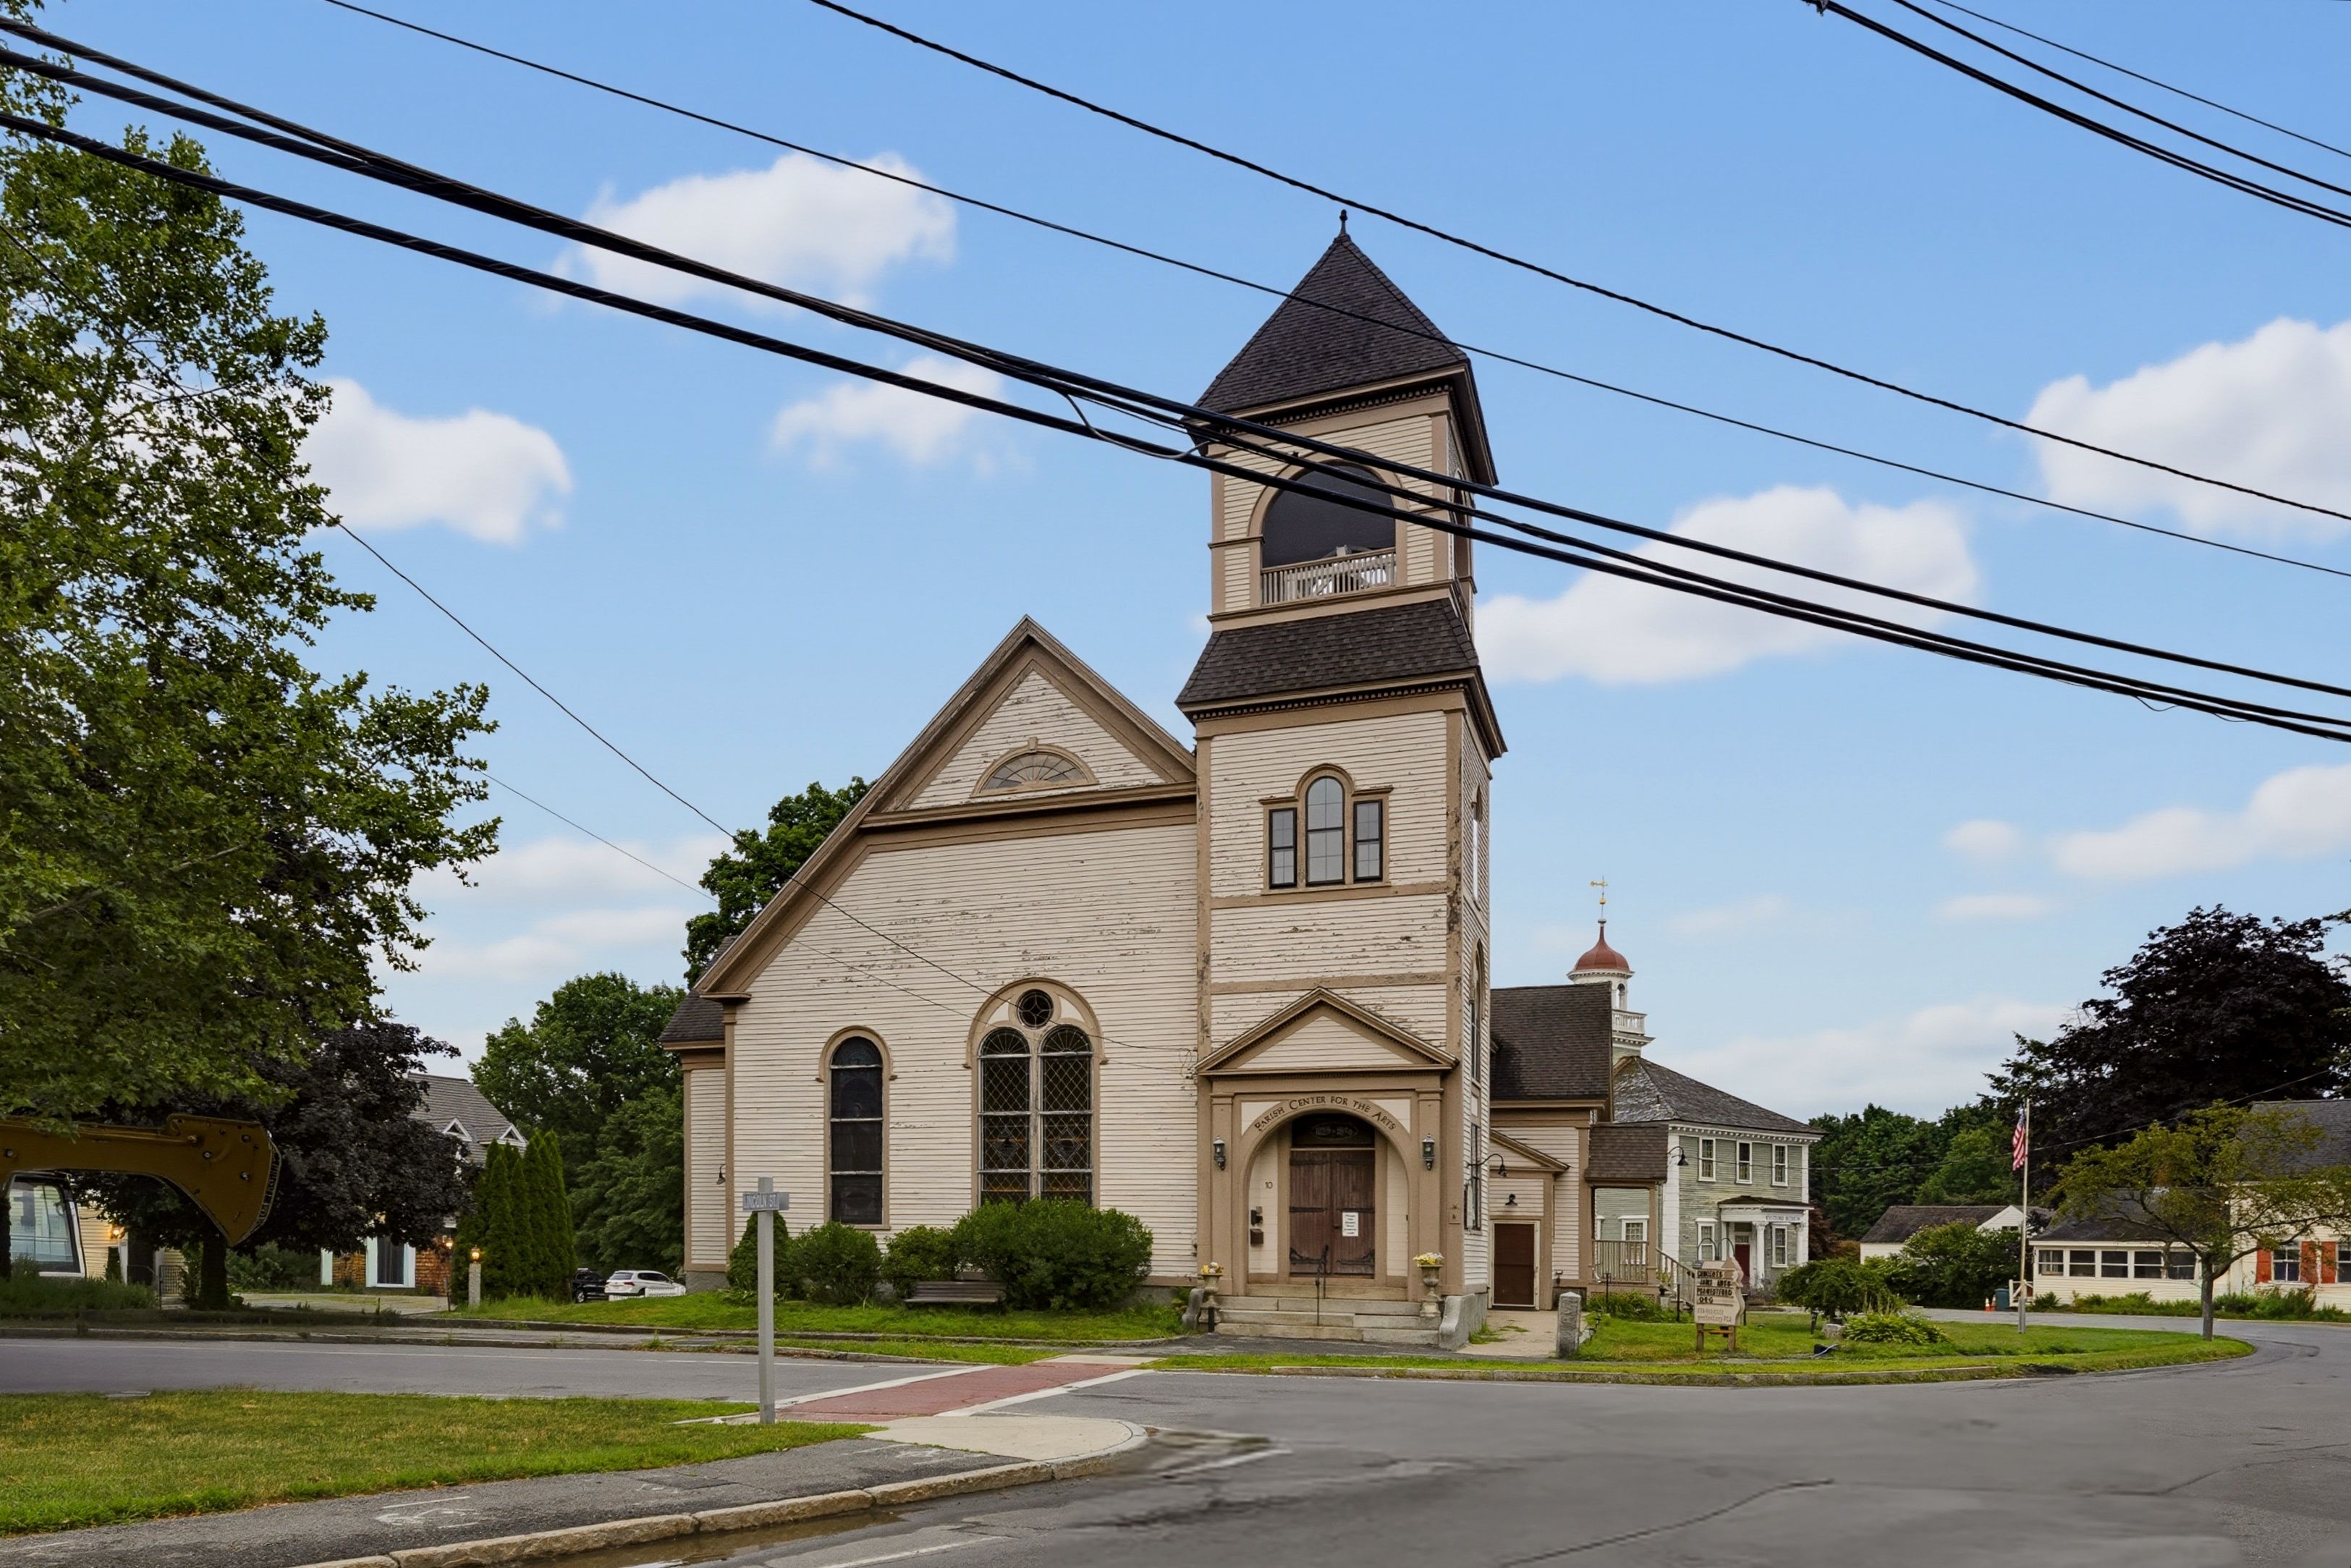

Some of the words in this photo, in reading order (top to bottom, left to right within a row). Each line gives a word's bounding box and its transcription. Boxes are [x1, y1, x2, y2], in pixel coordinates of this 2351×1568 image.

[1254, 1106, 1285, 1131] PARISH
[1289, 1096, 1326, 1110] CENTER
[1330, 1096, 1348, 1106] FOR
[1352, 1100, 1371, 1113] THE
[1372, 1111, 1397, 1130] ARTS
[1265, 1181, 1274, 1190] 10
[744, 1194, 767, 1208] LINCOLN
